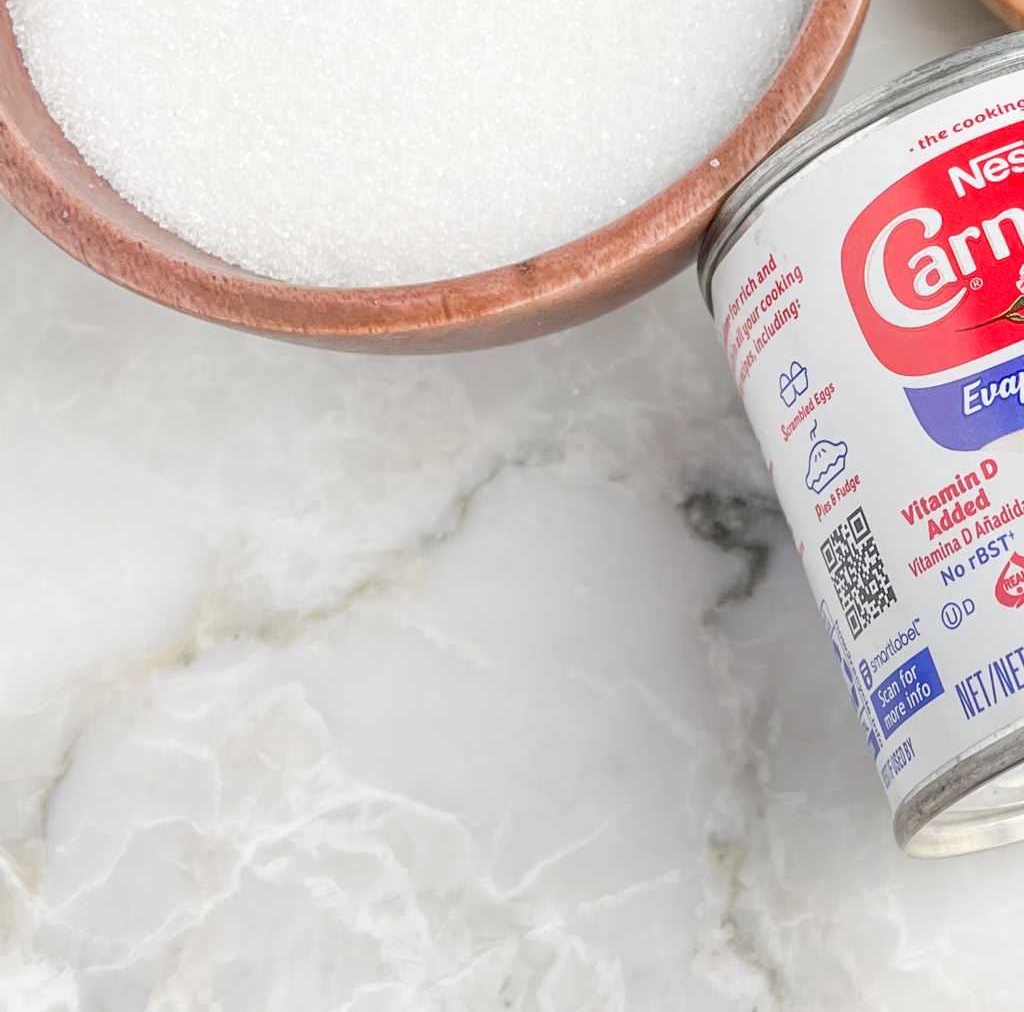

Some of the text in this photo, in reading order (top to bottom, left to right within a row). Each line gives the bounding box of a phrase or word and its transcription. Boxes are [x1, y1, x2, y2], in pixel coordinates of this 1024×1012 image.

[918, 128, 948, 151] the
[739, 276, 758, 304] rich
[756, 253, 778, 285] and
[742, 309, 761, 341] your
[760, 265, 804, 314] cooking
[753, 298, 802, 355] including:
[781, 382, 836, 442] Scrambled Eggs
[815, 501, 832, 523] Pies
[835, 475, 861, 502] Fudge
[900, 458, 998, 526] Vitamin D
[927, 487, 991, 541] Added
[908, 537, 962, 578] Vitamina
[961, 527, 973, 545] D
[940, 563, 966, 587] No
[877, 664, 918, 708] Scan for
[883, 681, 931, 730] more info
[903, 736, 916, 765] BY
